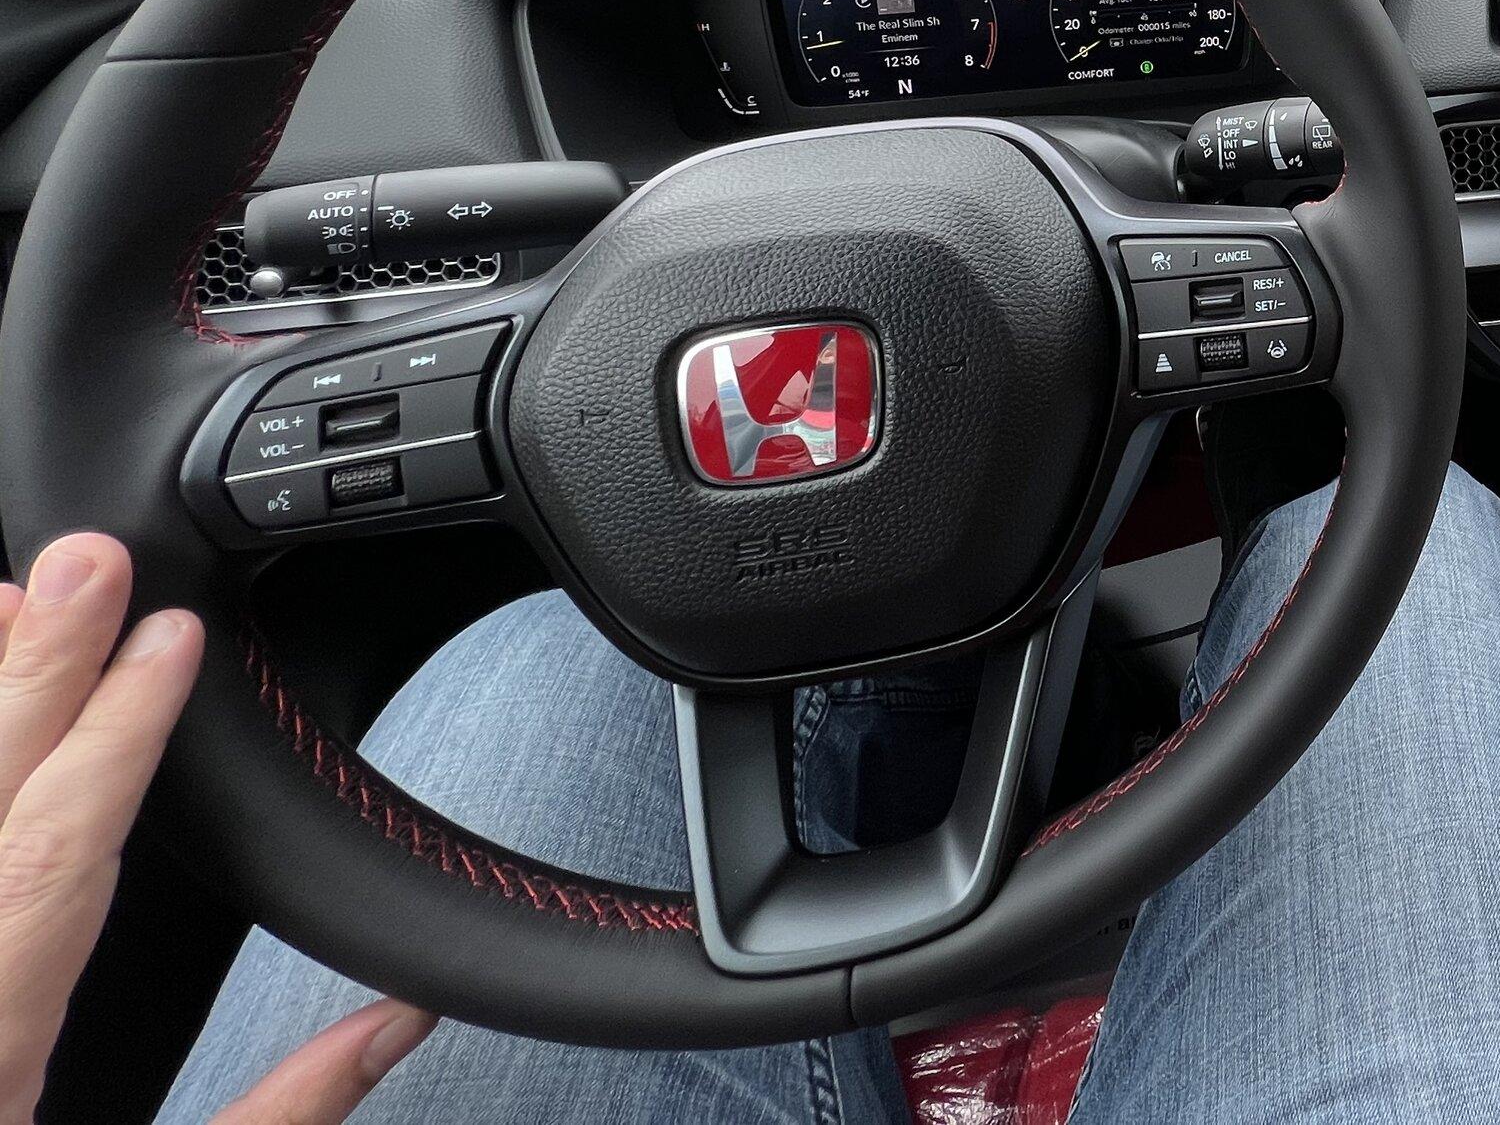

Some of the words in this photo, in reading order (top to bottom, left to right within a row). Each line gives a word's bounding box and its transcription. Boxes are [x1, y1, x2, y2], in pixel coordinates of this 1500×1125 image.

[1207, 8, 1226, 20] 180
[701, 23, 710, 32] H
[855, 21, 876, 31] The
[878, 19, 900, 30] Real
[902, 18, 924, 29] Slim
[927, 17, 940, 27] Sh
[970, 18, 980, 31] 7
[1064, 19, 1081, 31] 20
[1137, 21, 1171, 32] 000015
[816, 30, 824, 42] 1
[881, 33, 918, 44] Eminem
[1200, 36, 1220, 48] 200
[883, 56, 921, 68] 12:36
[964, 54, 974, 67] 8
[830, 65, 841, 78] 0
[1068, 69, 1114, 79] COMFORT
[898, 79, 912, 95] N
[848, 89, 870, 99] 54°F
[1223, 116, 1245, 125] MIST
[1223, 128, 1240, 138] OFF
[1223, 139, 1238, 148] INT
[1312, 140, 1333, 149] REAR
[1224, 151, 1237, 160] LO
[323, 189, 357, 201] OFF
[307, 206, 354, 220] AUTO
[1214, 250, 1252, 263] CANCEL
[1253, 278, 1284, 290] RES/+
